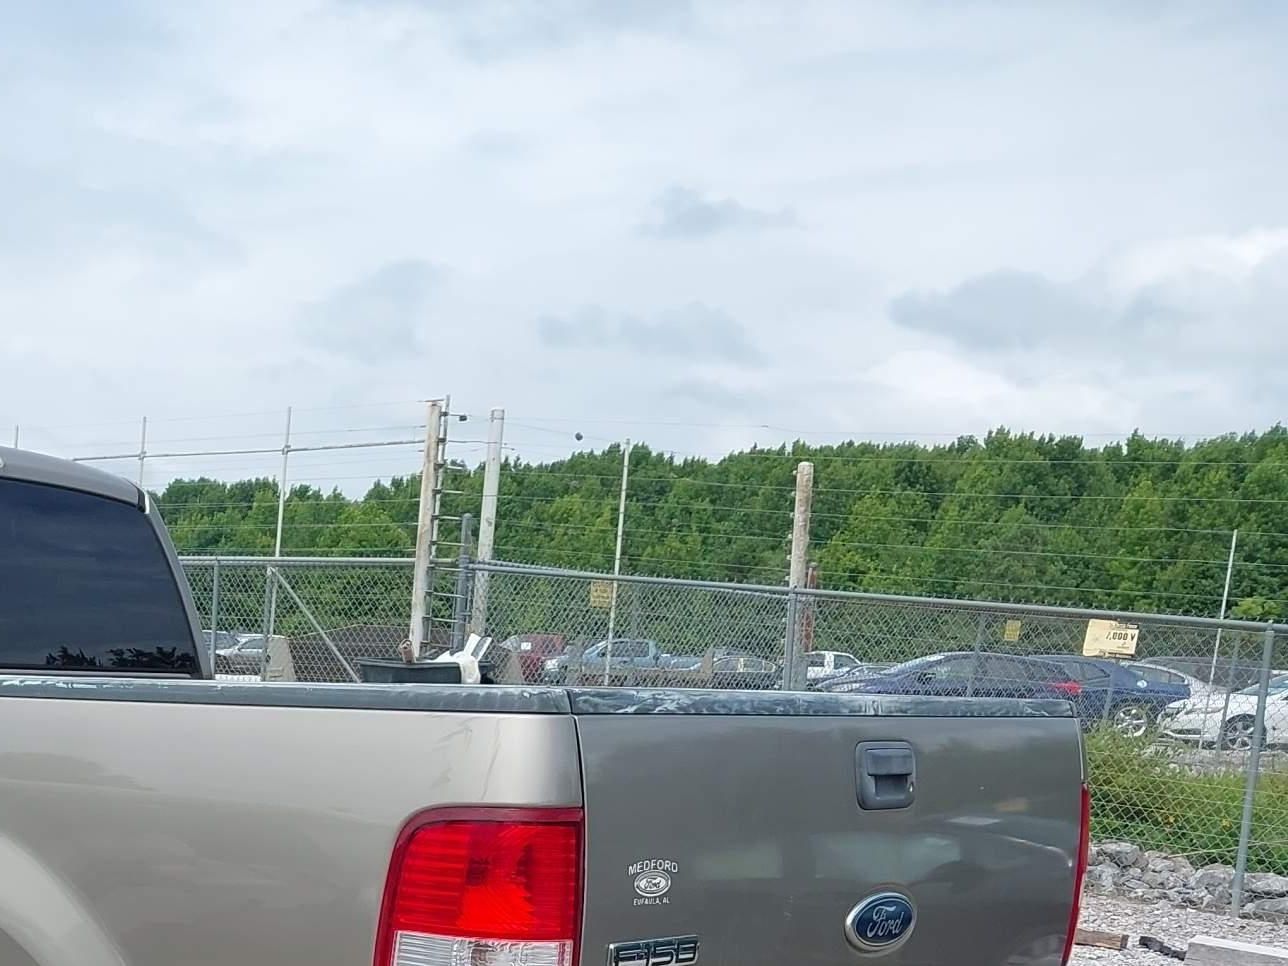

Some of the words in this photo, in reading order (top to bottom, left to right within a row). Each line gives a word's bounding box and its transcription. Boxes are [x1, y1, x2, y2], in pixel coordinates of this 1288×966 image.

[628, 859, 679, 876] MEDFORD
[663, 896, 671, 904] AL
[866, 905, 905, 938] Ford
